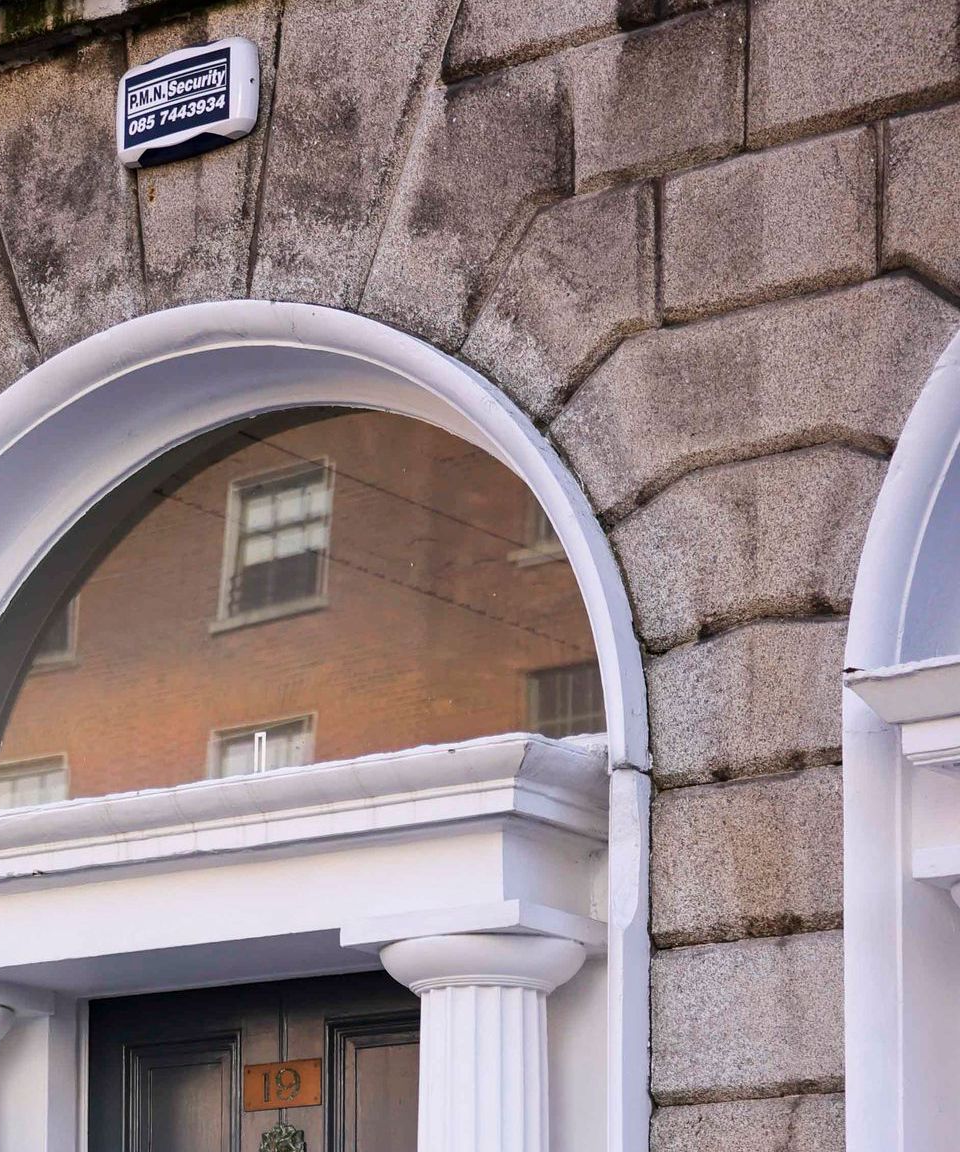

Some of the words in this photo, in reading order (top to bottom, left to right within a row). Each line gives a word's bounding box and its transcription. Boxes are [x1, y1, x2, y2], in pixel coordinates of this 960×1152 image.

[129, 84, 166, 110] P.M.N.
[168, 68, 226, 97] Security
[128, 114, 156, 136] 085
[159, 94, 226, 126] 7443934
[262, 1068, 301, 1103] 19
